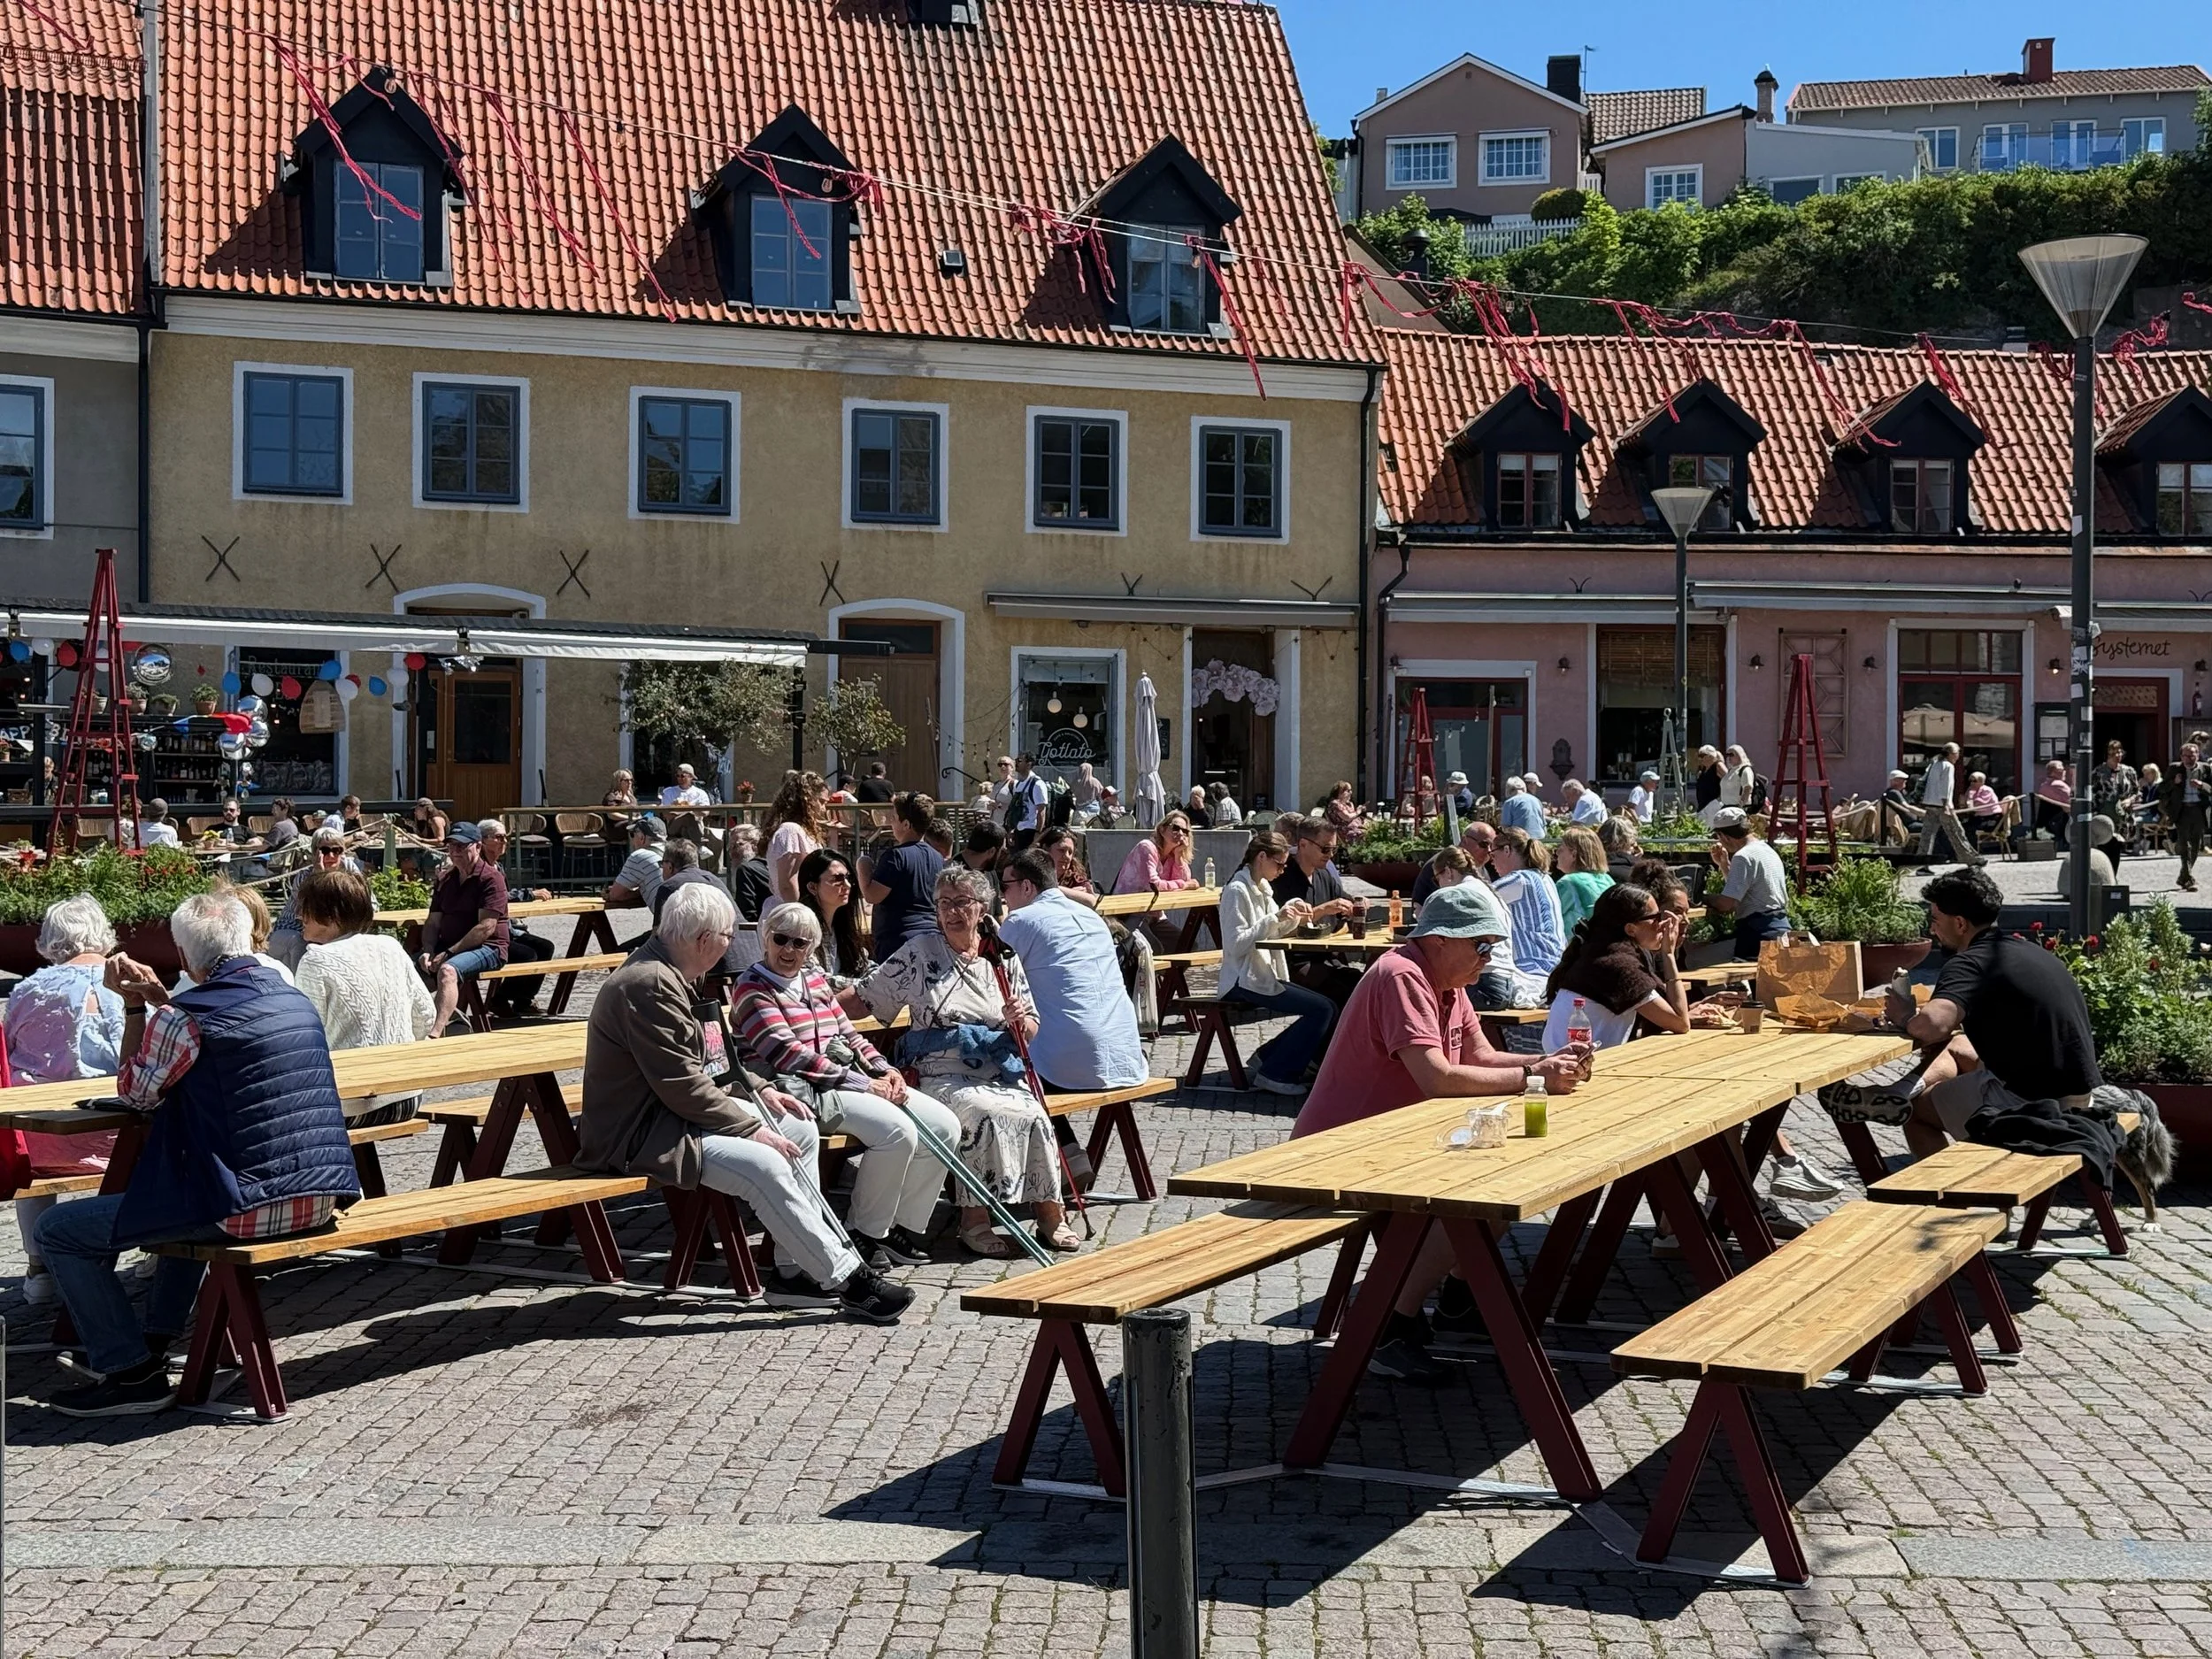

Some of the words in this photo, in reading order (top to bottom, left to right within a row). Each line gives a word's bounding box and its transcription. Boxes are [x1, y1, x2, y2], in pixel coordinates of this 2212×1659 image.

[248, 655, 326, 675] Restauran
[0, 724, 34, 741] APP
[1038, 741, 1097, 766] Gotlato
